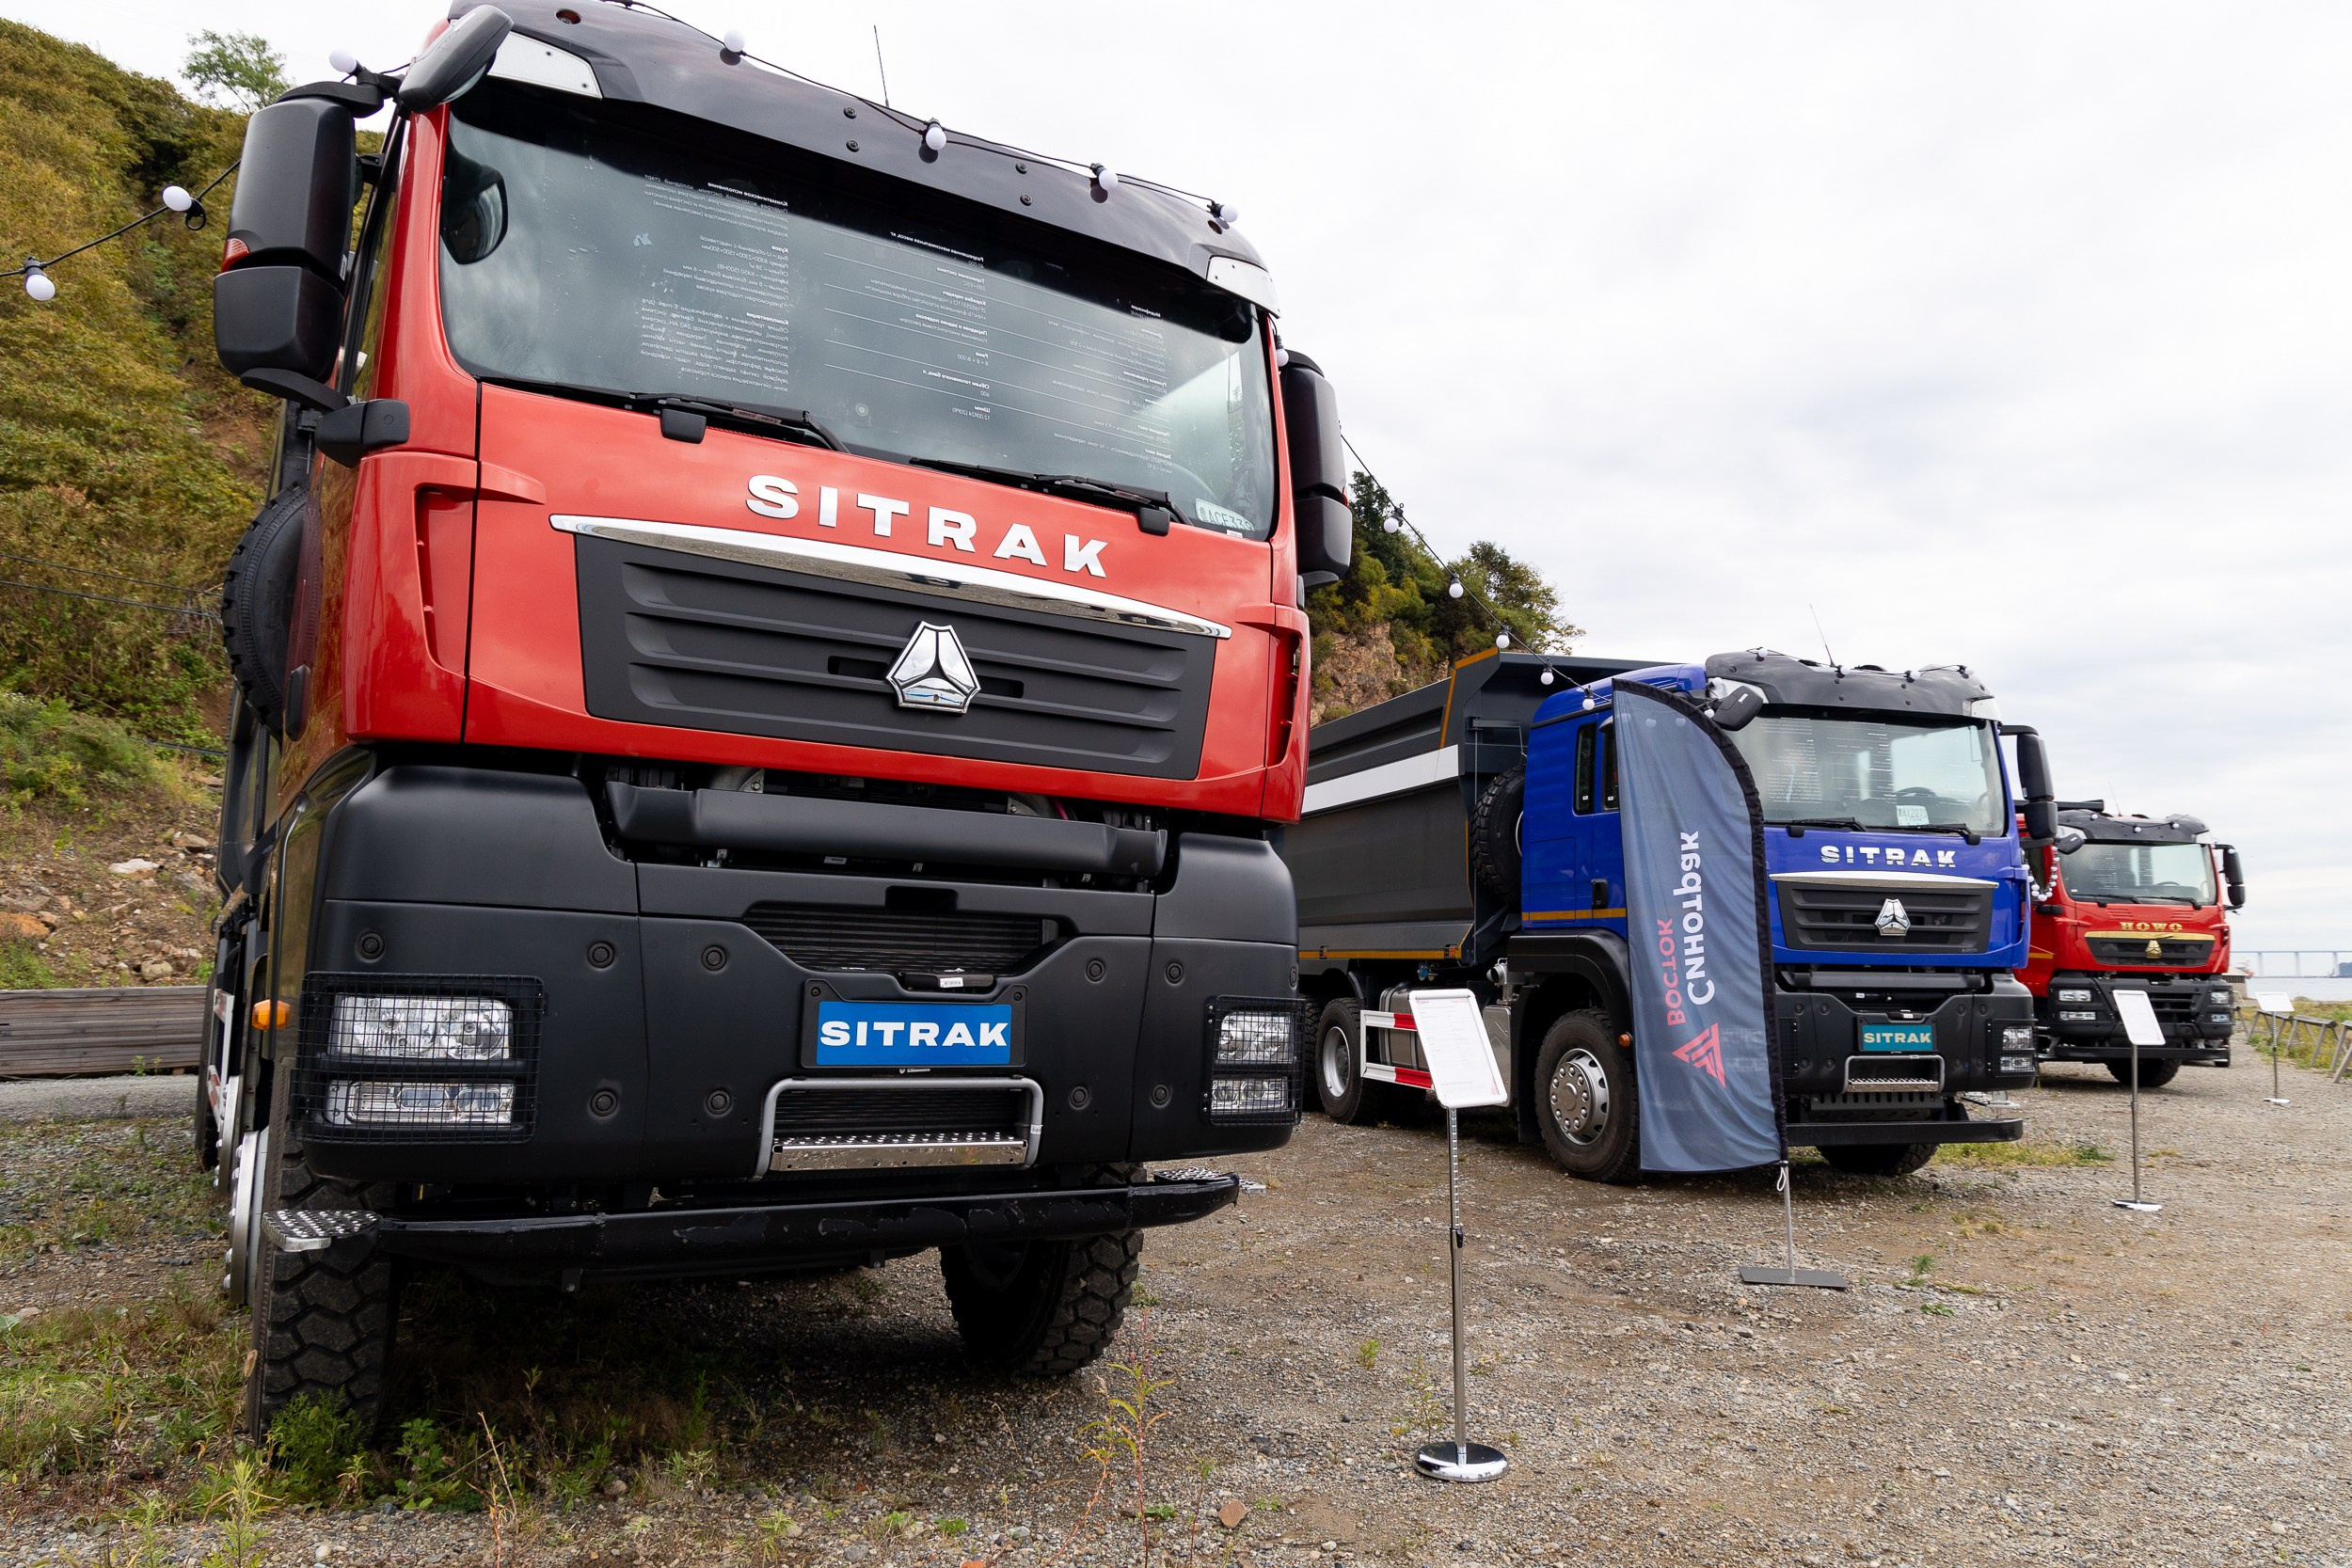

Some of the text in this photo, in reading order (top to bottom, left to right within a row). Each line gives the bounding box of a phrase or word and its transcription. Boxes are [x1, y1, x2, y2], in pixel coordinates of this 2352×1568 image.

[745, 475, 1108, 578] SITRAK
[1820, 845, 1956, 867] SITRAK
[2120, 922, 2183, 932] HOWO
[819, 1020, 1009, 1047] SITRAK
[1864, 1032, 1931, 1044] SITRAK
